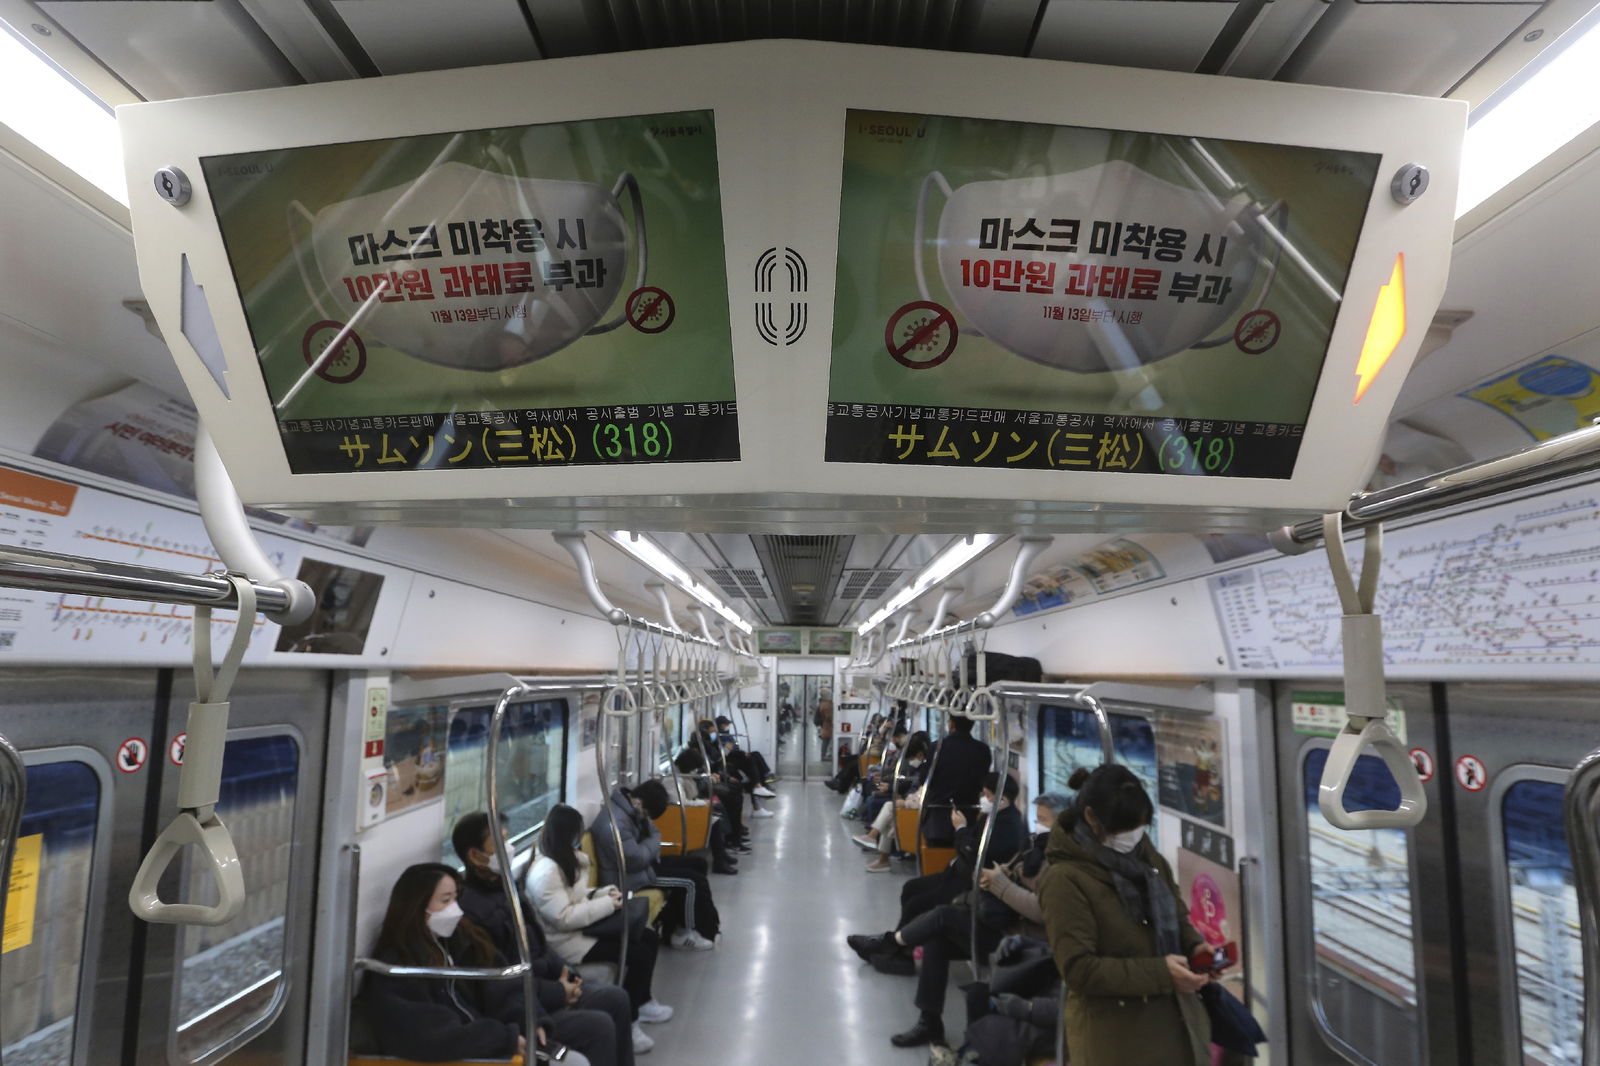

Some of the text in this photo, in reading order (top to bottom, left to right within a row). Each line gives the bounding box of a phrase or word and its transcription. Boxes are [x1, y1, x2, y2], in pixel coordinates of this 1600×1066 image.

[348, 219, 587, 266] 마스크 미착용 시
[979, 218, 1227, 267] 마스크 미착용 시
[342, 258, 607, 303] 10만원 과태료 부과
[961, 259, 1232, 305] 10만원 과태료 부과
[431, 309, 453, 323] 11월
[454, 306, 501, 322] 13일부터
[1043, 306, 1143, 325] 11월 13일부터 시행
[443, 411, 518, 427] 서울교통공사
[526, 408, 578, 422] 역사에서
[648, 404, 675, 418] 기념
[683, 402, 737, 416] 교통카드
[1014, 412, 1095, 427] 서울교통공사
[1103, 415, 1154, 431] 역사에서
[1221, 422, 1246, 435] 기념
[592, 420, 673, 460] (318)
[1158, 433, 1235, 473] (318)
